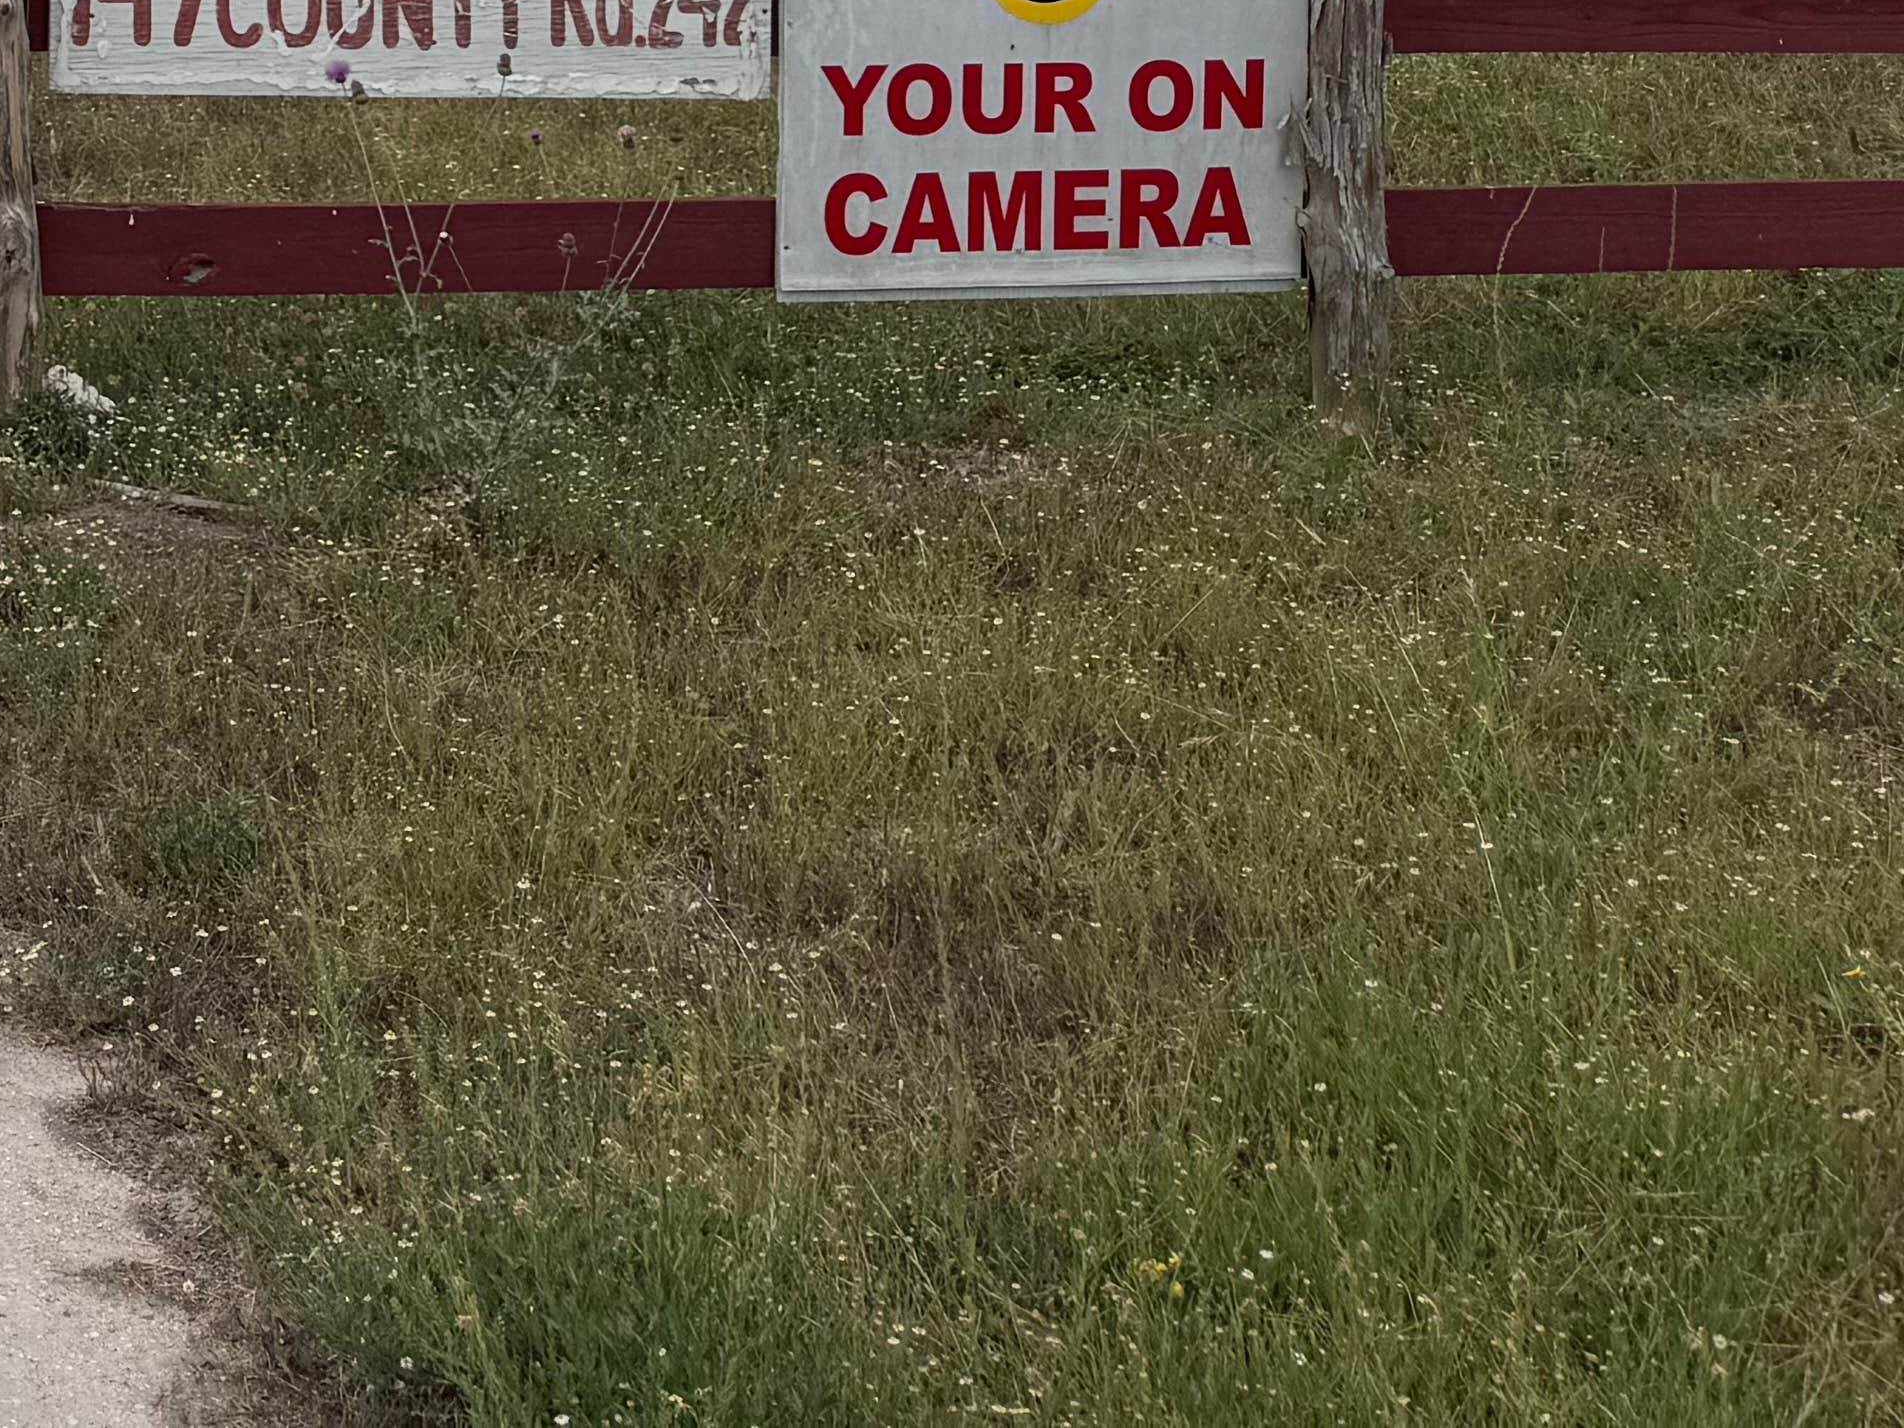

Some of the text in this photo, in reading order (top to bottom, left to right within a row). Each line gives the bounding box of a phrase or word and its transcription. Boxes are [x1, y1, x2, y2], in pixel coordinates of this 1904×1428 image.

[820, 59, 1265, 137] YOUR ON
[825, 166, 1251, 257] CAMERA
